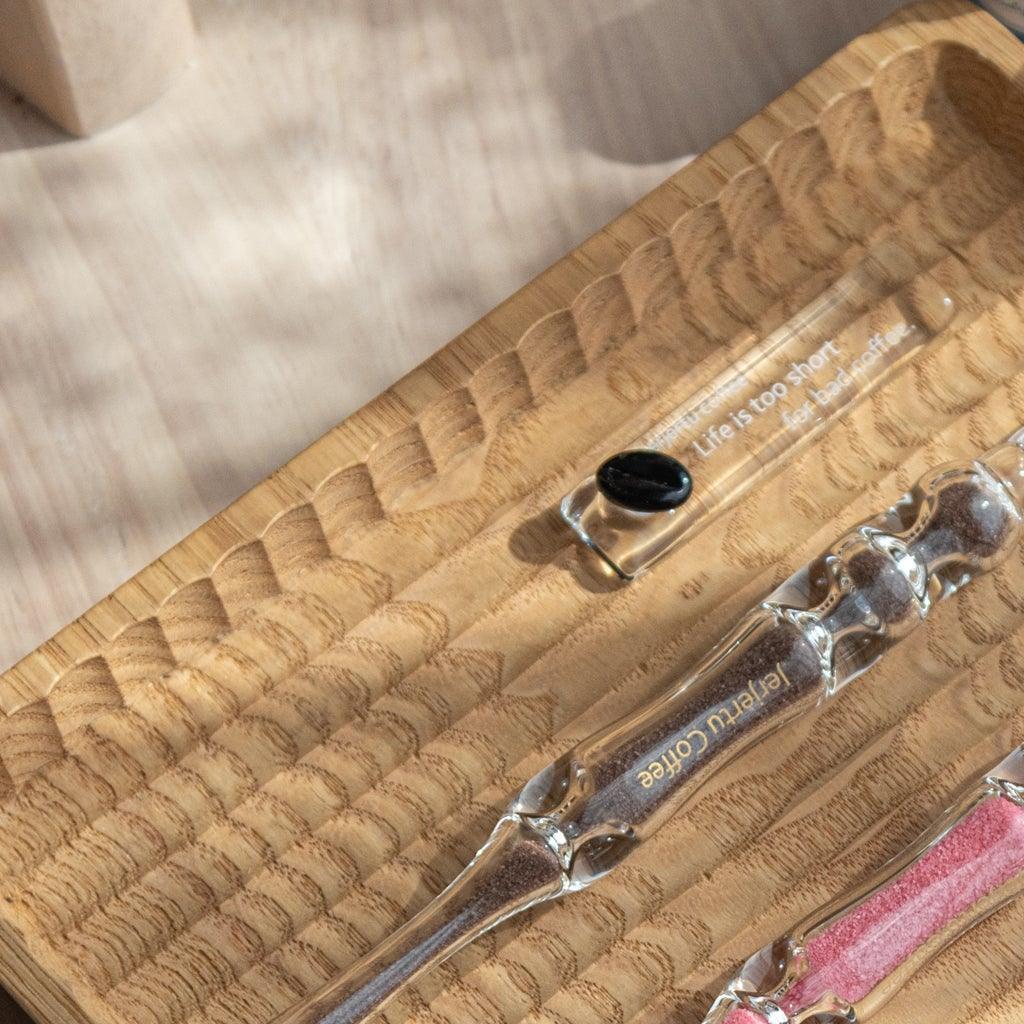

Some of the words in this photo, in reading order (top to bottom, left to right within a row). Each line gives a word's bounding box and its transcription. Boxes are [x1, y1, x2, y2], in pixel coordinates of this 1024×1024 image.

[692, 425, 735, 457] Life
[729, 409, 753, 429] is
[749, 382, 788, 412] too
[787, 340, 842, 386] short
[782, 401, 815, 432] for
[810, 367, 855, 406] bad
[706, 662, 791, 735] Jerjertu
[637, 729, 709, 788] Coffee
